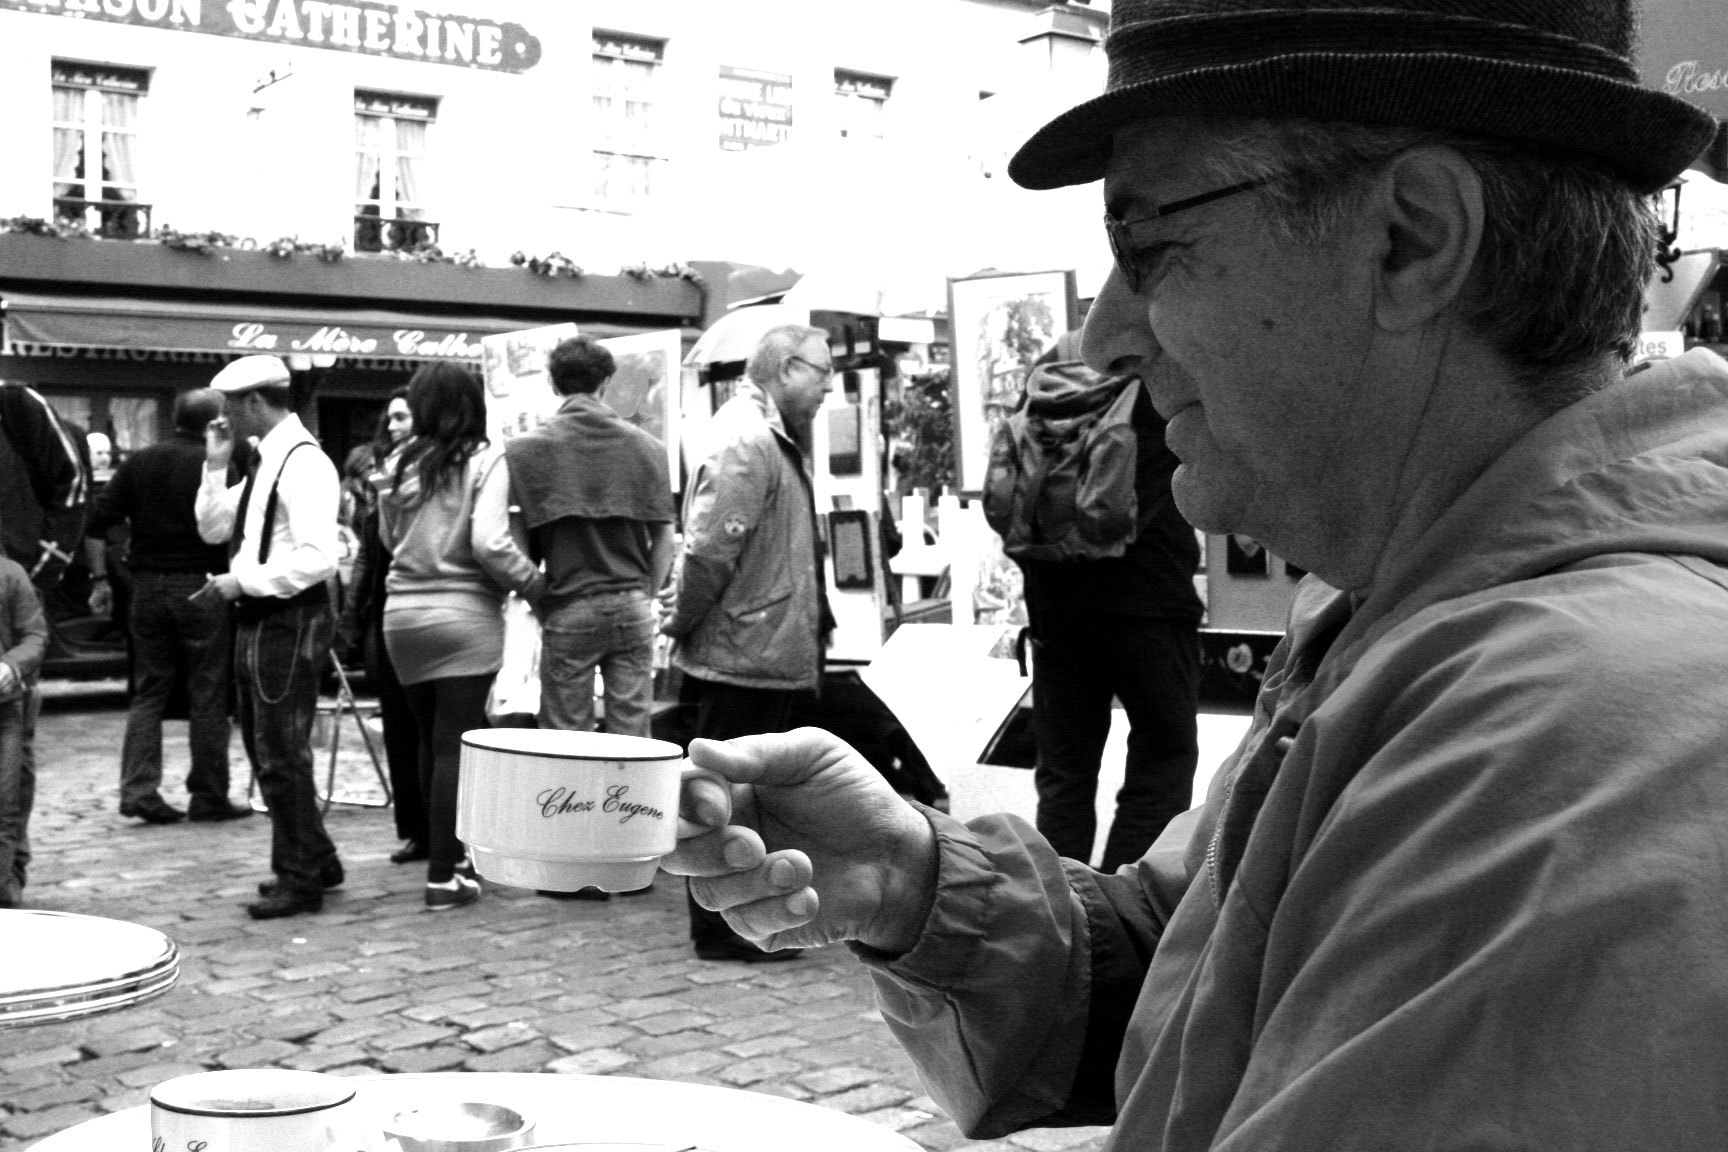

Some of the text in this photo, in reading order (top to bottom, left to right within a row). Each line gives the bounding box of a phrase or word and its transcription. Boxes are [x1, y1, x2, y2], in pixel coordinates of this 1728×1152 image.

[228, 323, 277, 349] La
[536, 785, 664, 824] Chez Eugene
